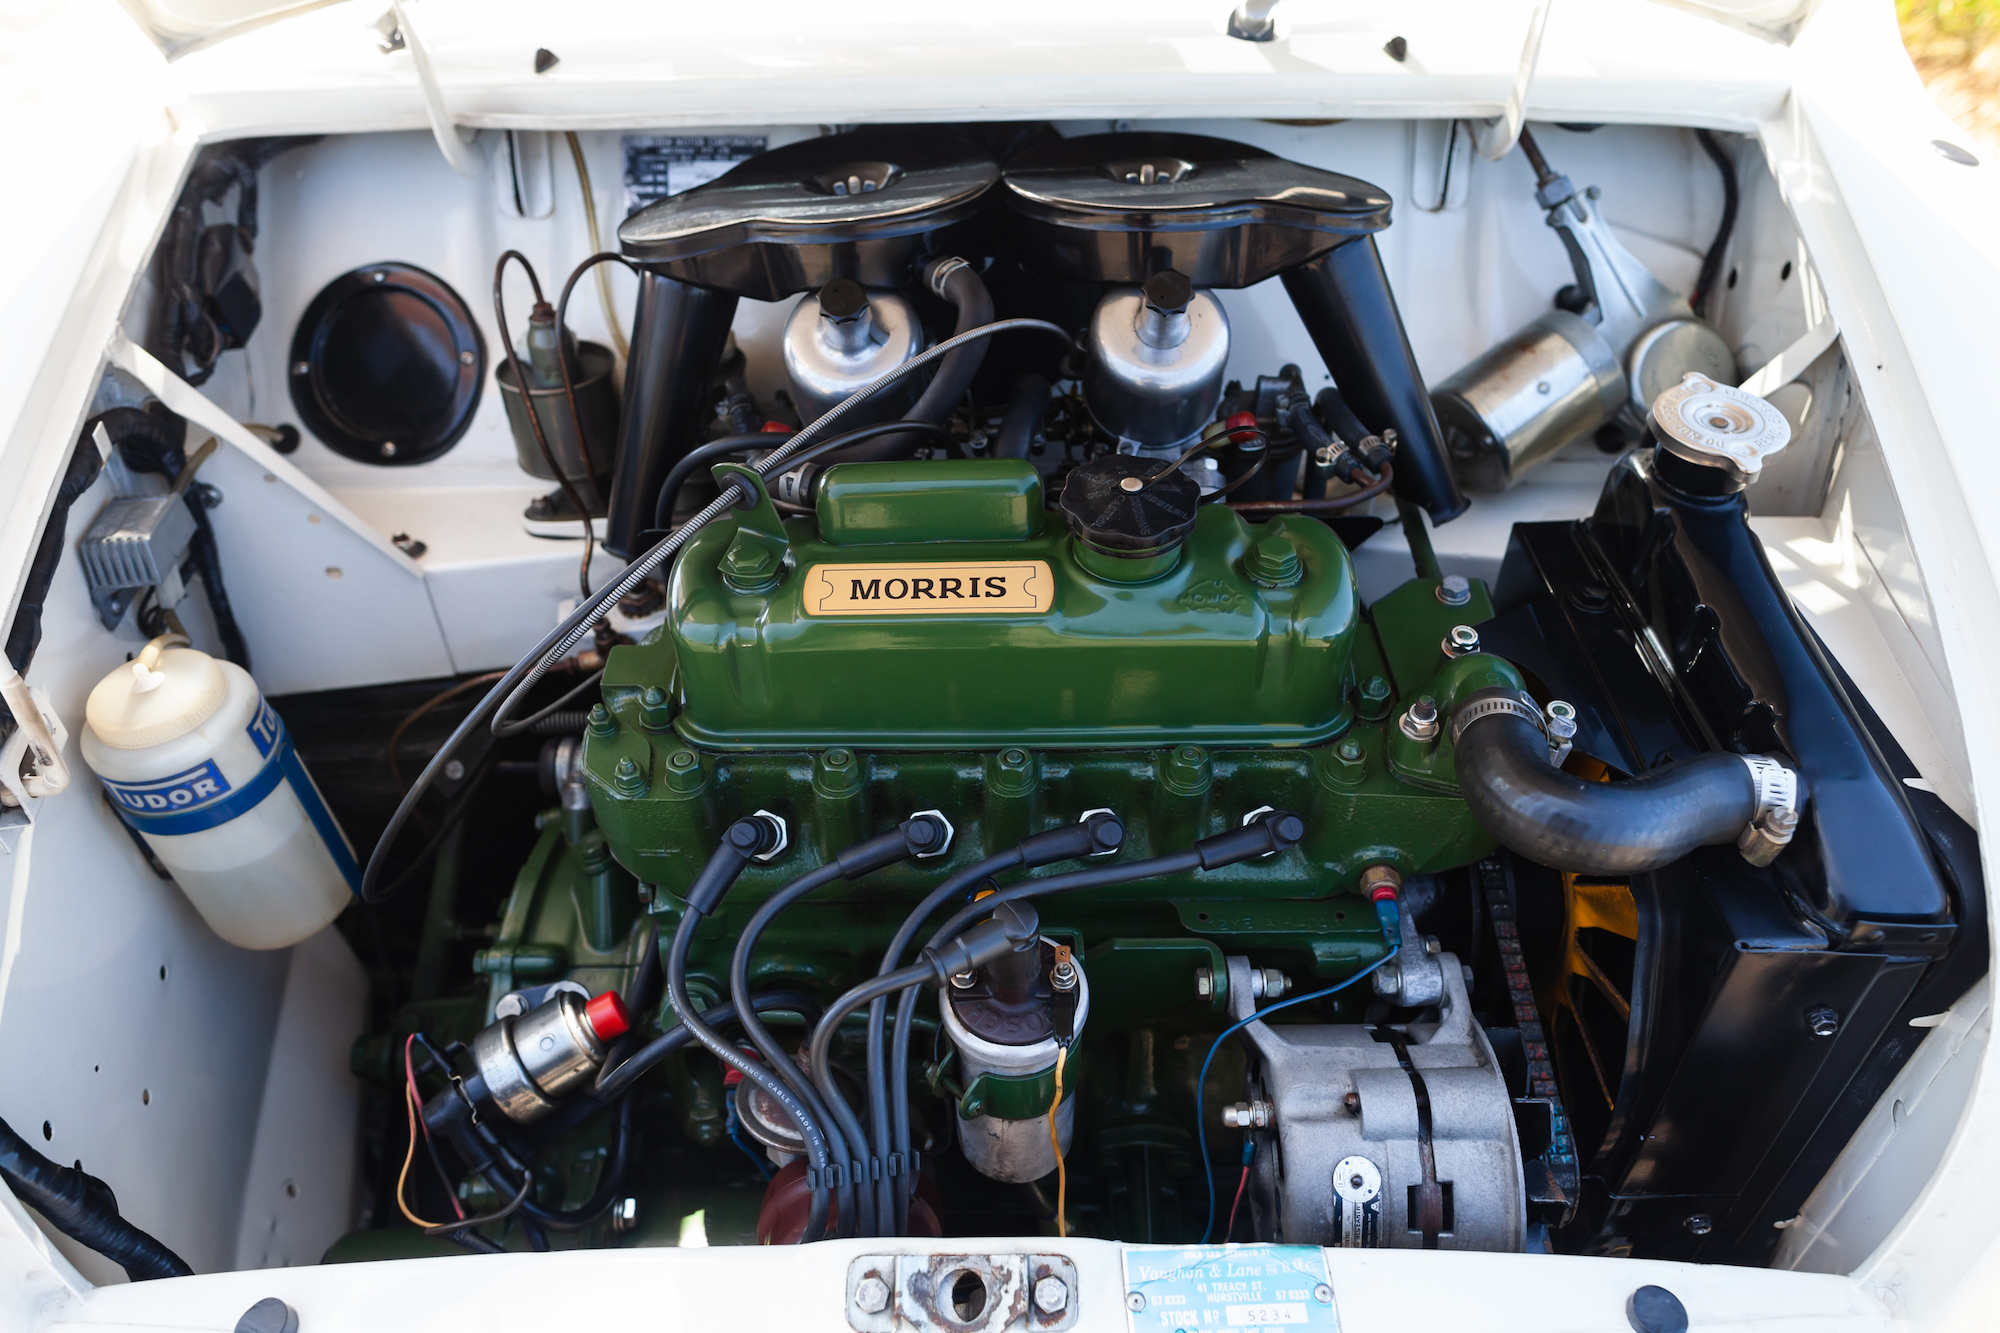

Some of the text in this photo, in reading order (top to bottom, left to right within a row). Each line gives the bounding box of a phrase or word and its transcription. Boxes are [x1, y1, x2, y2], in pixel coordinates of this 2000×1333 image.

[1722, 388, 1783, 448] REMOVE SLOWLY
[1705, 437, 1726, 449] DO
[849, 576, 1007, 600] MORRIS
[102, 766, 221, 810] TUDOR
[683, 1019, 826, 1169] SILICONE PERFORMANCE CABLE MADE IN USA
[1184, 1248, 1271, 1259] SOLD AND SERVICED BY
[1138, 1263, 1205, 1282] Vaughan
[1208, 1265, 1222, 1278] &
[1226, 1263, 1262, 1278] Lane
[1281, 1260, 1318, 1273] B.M.C.
[1197, 1280, 1267, 1293] 41 TREACY ST.
[1151, 1294, 1187, 1306] 57 0333
[1206, 1291, 1262, 1304] HURSTVILLE
[1276, 1289, 1311, 1300] 57 0333
[1160, 1309, 1199, 1327] STOCK
[1248, 1309, 1292, 1322] 5234
